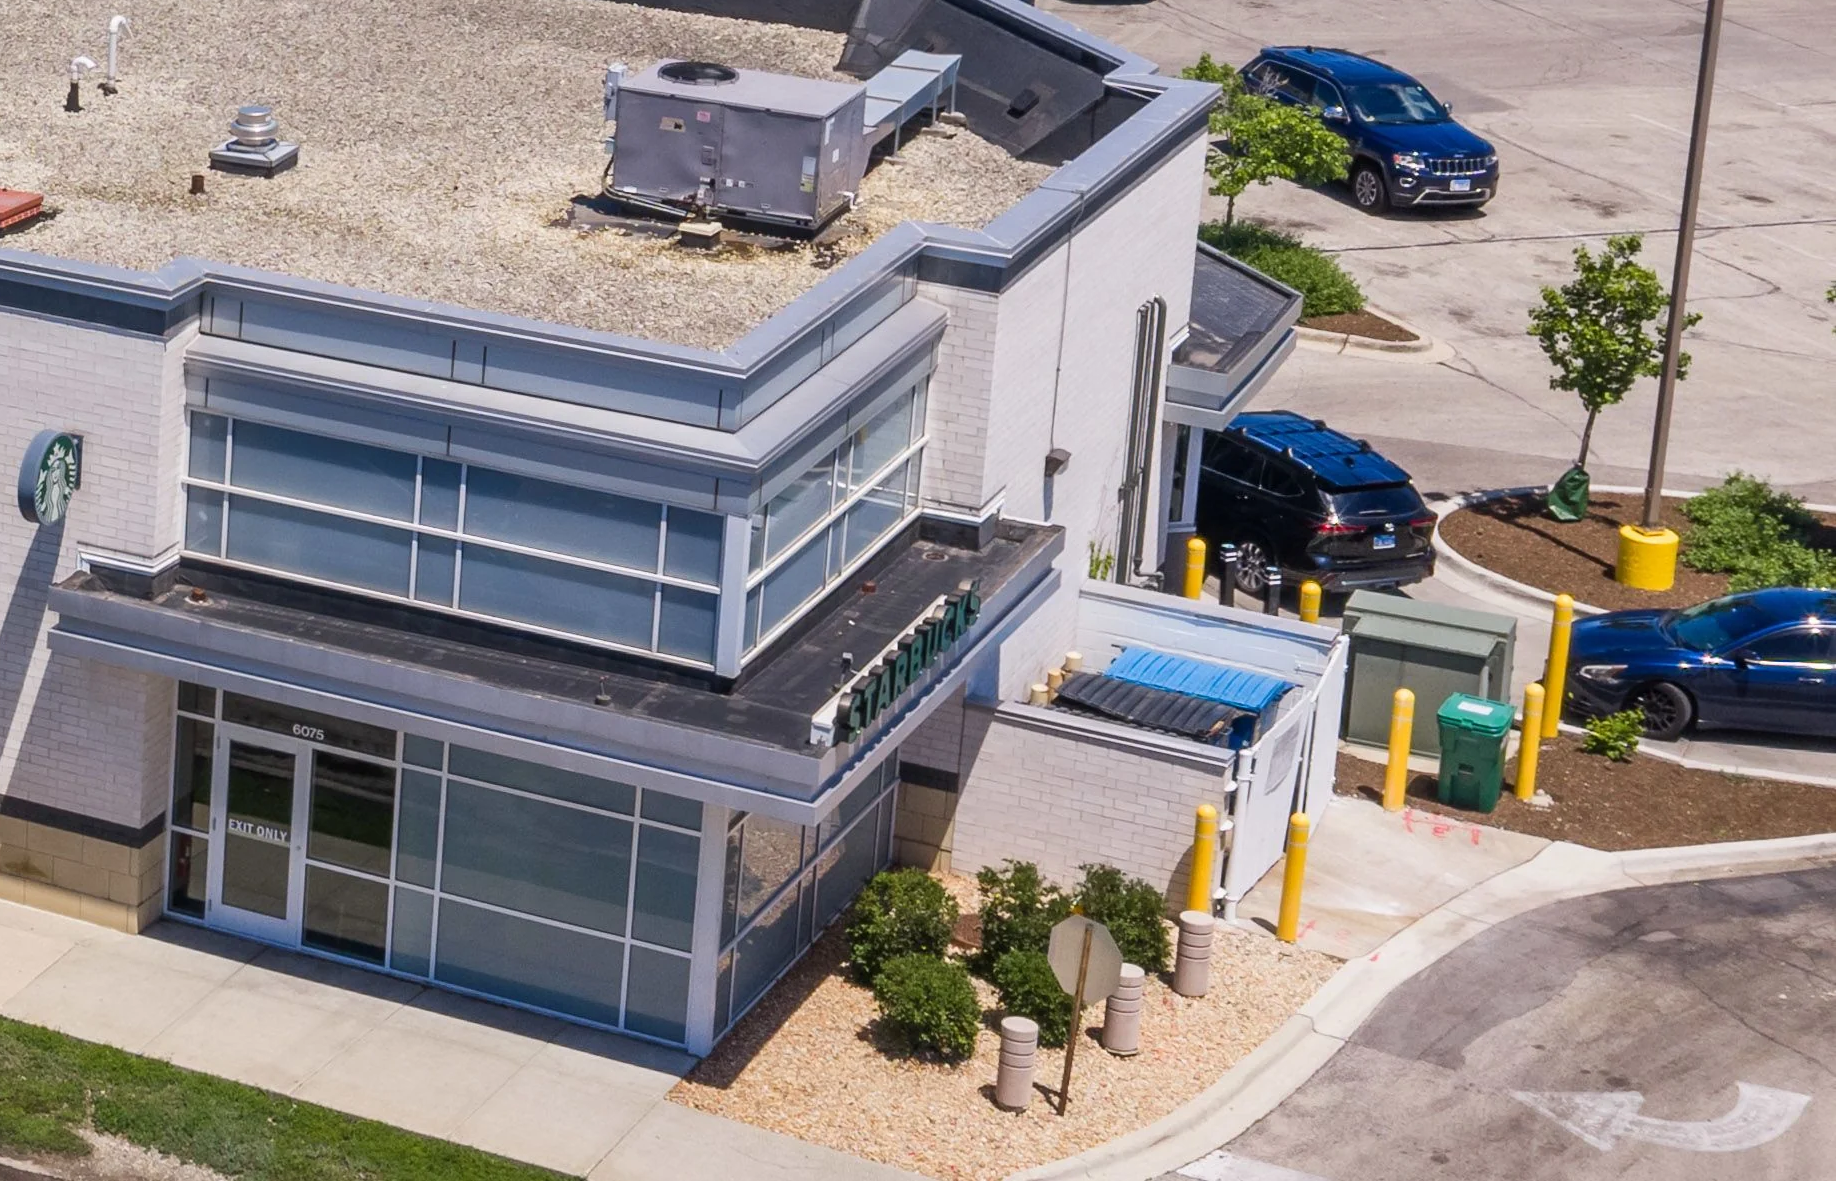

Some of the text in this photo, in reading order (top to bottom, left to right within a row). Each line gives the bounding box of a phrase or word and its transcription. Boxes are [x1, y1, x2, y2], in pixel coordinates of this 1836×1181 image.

[839, 579, 981, 744] STARBUCKS
[292, 723, 325, 740] 6075
[229, 818, 288, 841] EXIT ONLY
